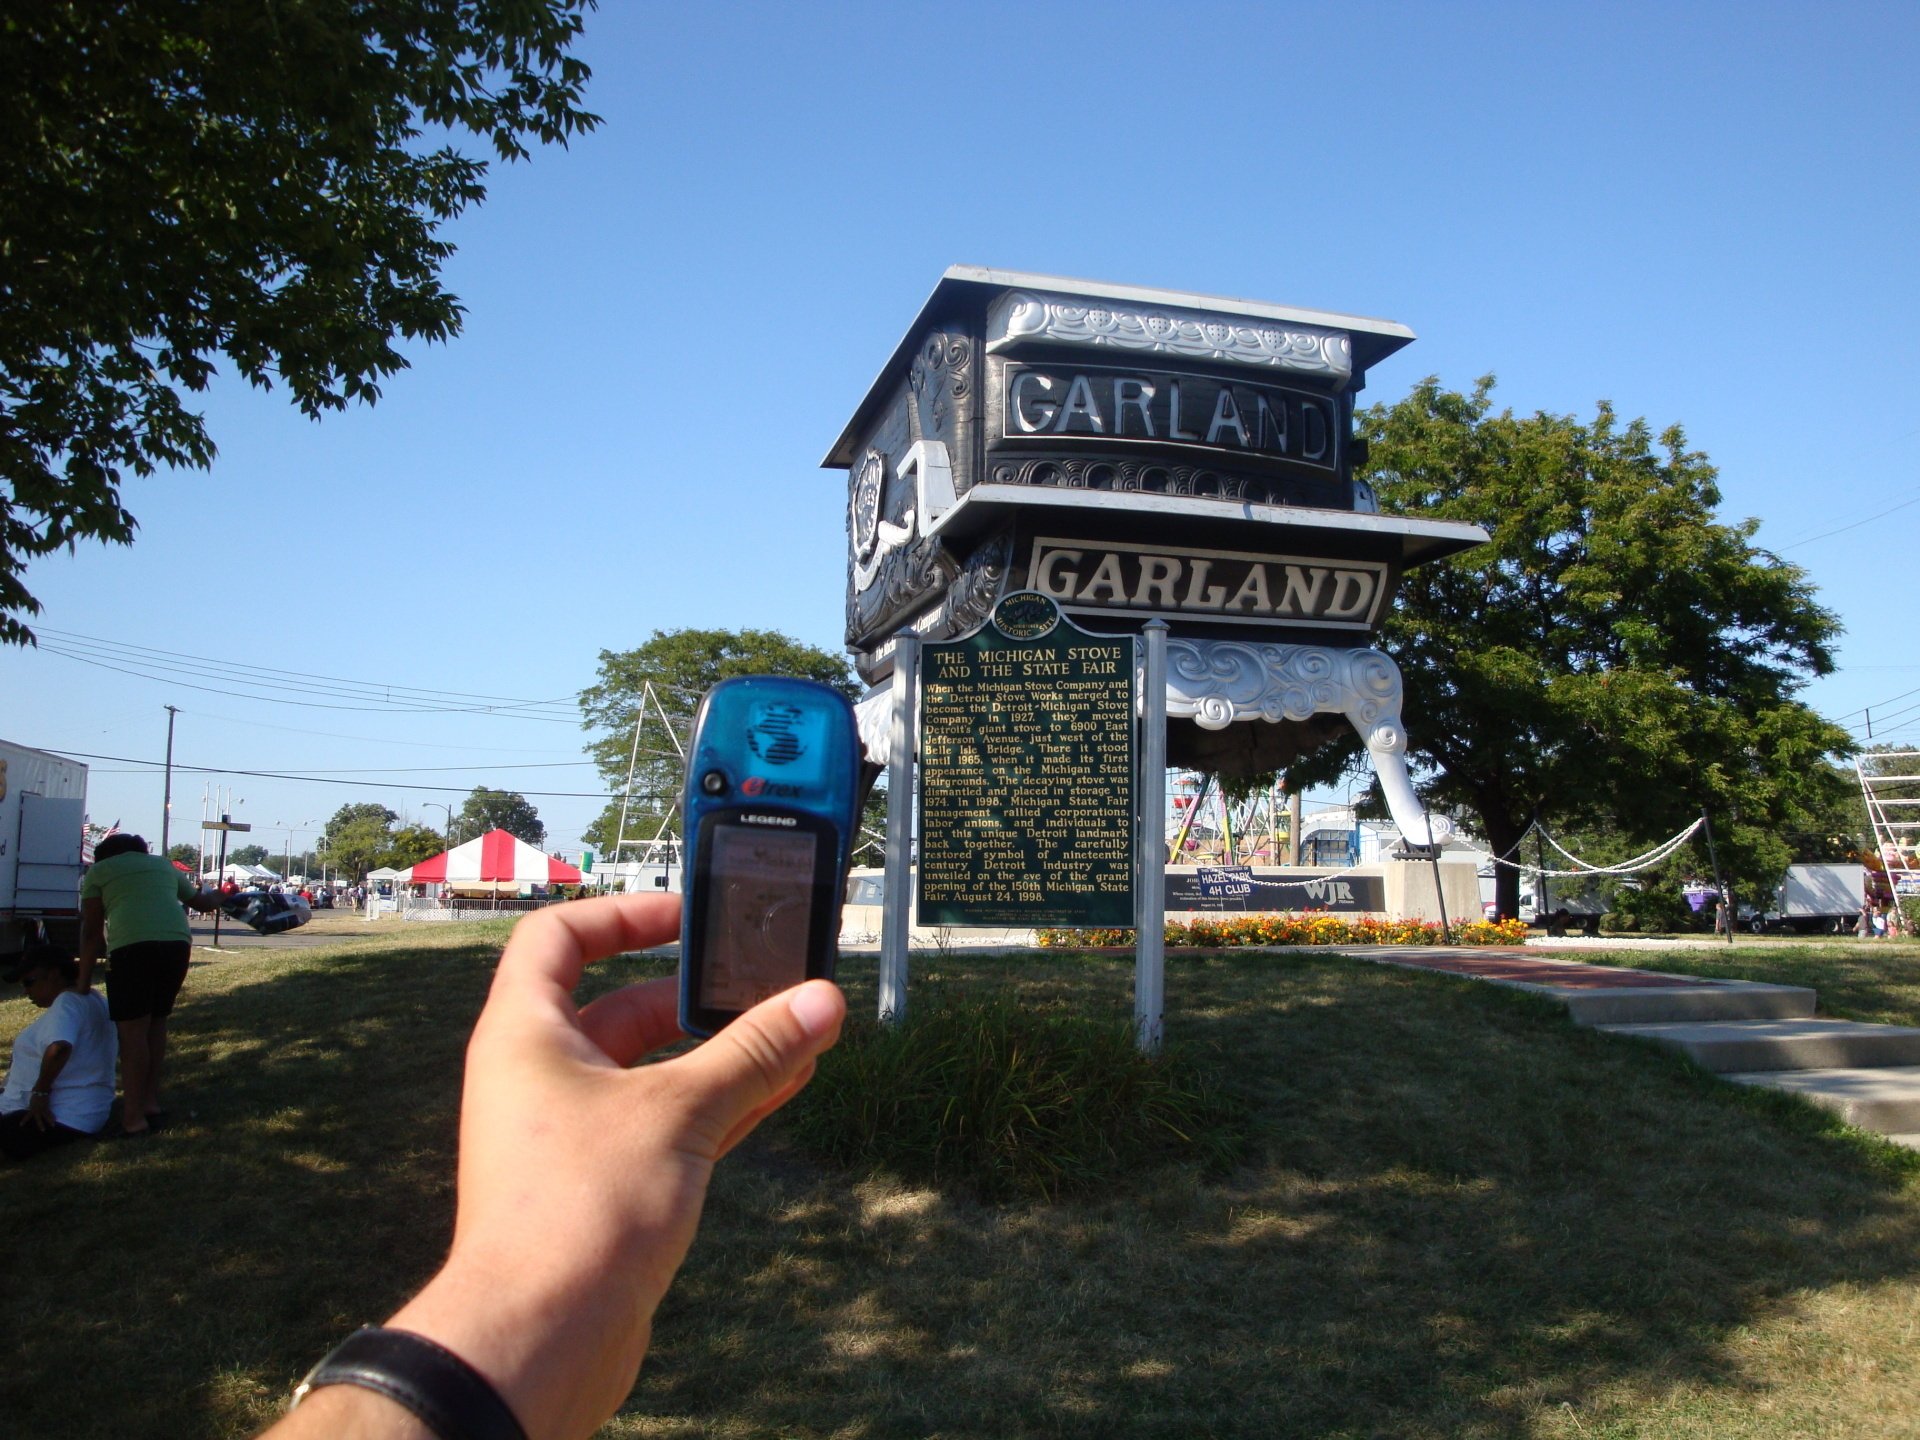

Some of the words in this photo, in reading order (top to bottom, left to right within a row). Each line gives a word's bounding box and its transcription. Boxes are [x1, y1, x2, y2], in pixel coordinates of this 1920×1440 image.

[1010, 371, 1328, 461] GARLAND
[1036, 549, 1376, 618] GARLAND
[1005, 594, 1047, 606] MICHIGAN
[996, 617, 1032, 636] HISTORIC
[1038, 616, 1056, 632] SITE
[934, 652, 965, 664] THE
[978, 649, 1055, 662] MICHIGAN
[1068, 647, 1121, 660] STOVE
[939, 666, 970, 678] AND
[981, 664, 1012, 677] THE
[1023, 663, 1070, 675] STATE
[1083, 662, 1116, 673] FAIR
[926, 684, 954, 693] When
[957, 684, 973, 692] the
[977, 682, 1022, 693] Michigan
[1025, 682, 1052, 690] Stove
[1056, 681, 1105, 691] Company
[1109, 680, 1128, 688] and
[926, 695, 943, 703] the
[950, 694, 989, 703] Detroit
[996, 693, 1025, 702] Stove
[1031, 692, 1063, 700] Works
[1069, 690, 1109, 700] merged
[926, 705, 965, 714] become
[970, 704, 987, 712] the
[992, 702, 1090, 712] Detroit-Michigan
[1098, 701, 1128, 710] Stove
[926, 716, 975, 726] Company
[1052, 713, 1078, 722] they
[926, 726, 971, 735] Detroit's
[979, 725, 1006, 735] giant
[1014, 724, 1041, 732] stove
[1070, 723, 1096, 731] 6900
[1105, 722, 1128, 730] East
[925, 736, 975, 744] Jefferson
[1029, 734, 1051, 744] just
[1091, 733, 1104, 741] of
[925, 746, 952, 754] Belle
[960, 745, 977, 754] Isle
[1038, 744, 1071, 753] There
[1080, 744, 1088, 752] it
[1097, 744, 1128, 752] stood
[925, 756, 950, 765] until
[992, 755, 1017, 764] when
[1026, 755, 1034, 763] it
[1043, 754, 1071, 763] made
[1080, 754, 1094, 762] its
[1103, 754, 1128, 762] first
[925, 767, 984, 776] appearance
[1014, 765, 1031, 774] the
[1041, 765, 1090, 775] Michigan
[1099, 765, 1128, 773] State
[925, 777, 989, 787] Fairgrounds.
[997, 776, 1018, 785] The
[1023, 776, 1072, 786] decaying
[925, 787, 982, 796] dismantled
[988, 787, 1007, 795] and
[1014, 787, 1048, 797] placed
[1053, 787, 1064, 795] in
[1070, 787, 1110, 796] storage
[925, 798, 949, 806] 1974.
[958, 798, 968, 806] In
[1011, 798, 1060, 807] Michigan
[1069, 797, 1098, 805] State
[1107, 797, 1128, 805] Fair
[925, 809, 990, 819] management
[1004, 808, 1040, 817] rallied
[740, 814, 797, 826] LEGEND
[925, 819, 953, 827] labor
[1014, 818, 1033, 827] and
[1046, 818, 1106, 827] individuals
[925, 830, 943, 839] put
[952, 830, 972, 838] this
[981, 830, 1018, 839] unique
[1027, 829, 1067, 837] Detroit
[1076, 829, 1128, 837] landmark
[925, 840, 949, 849] back
[965, 840, 1015, 850] together.
[1036, 839, 1058, 848] The
[1075, 839, 1128, 849] carefully
[925, 850, 972, 859] restored
[984, 850, 1024, 860] symbol
[1037, 850, 1049, 858] of
[1063, 850, 1128, 858] nineteenth-
[924, 861, 968, 871] century
[984, 861, 1026, 870] Detroit
[1043, 861, 1092, 871] industry
[925, 872, 971, 880] unveiled
[997, 872, 1015, 880] the
[1050, 872, 1064, 880] of
[1070, 872, 1087, 880] the
[1096, 872, 1128, 882] grand
[1202, 874, 1228, 884] HAZEL
[1230, 872, 1251, 882] PARK
[924, 882, 966, 892] opening
[972, 882, 985, 891] of
[989, 882, 1006, 891] the
[1012, 882, 1040, 891] 150th
[1047, 882, 1095, 893] Michigan
[1100, 883, 1128, 892] State
[1209, 886, 1222, 895] 4H
[1226, 884, 1250, 894] CLUB
[954, 893, 992, 903] August
[1019, 893, 1045, 901] 1998.
[1304, 882, 1354, 906] WJR
